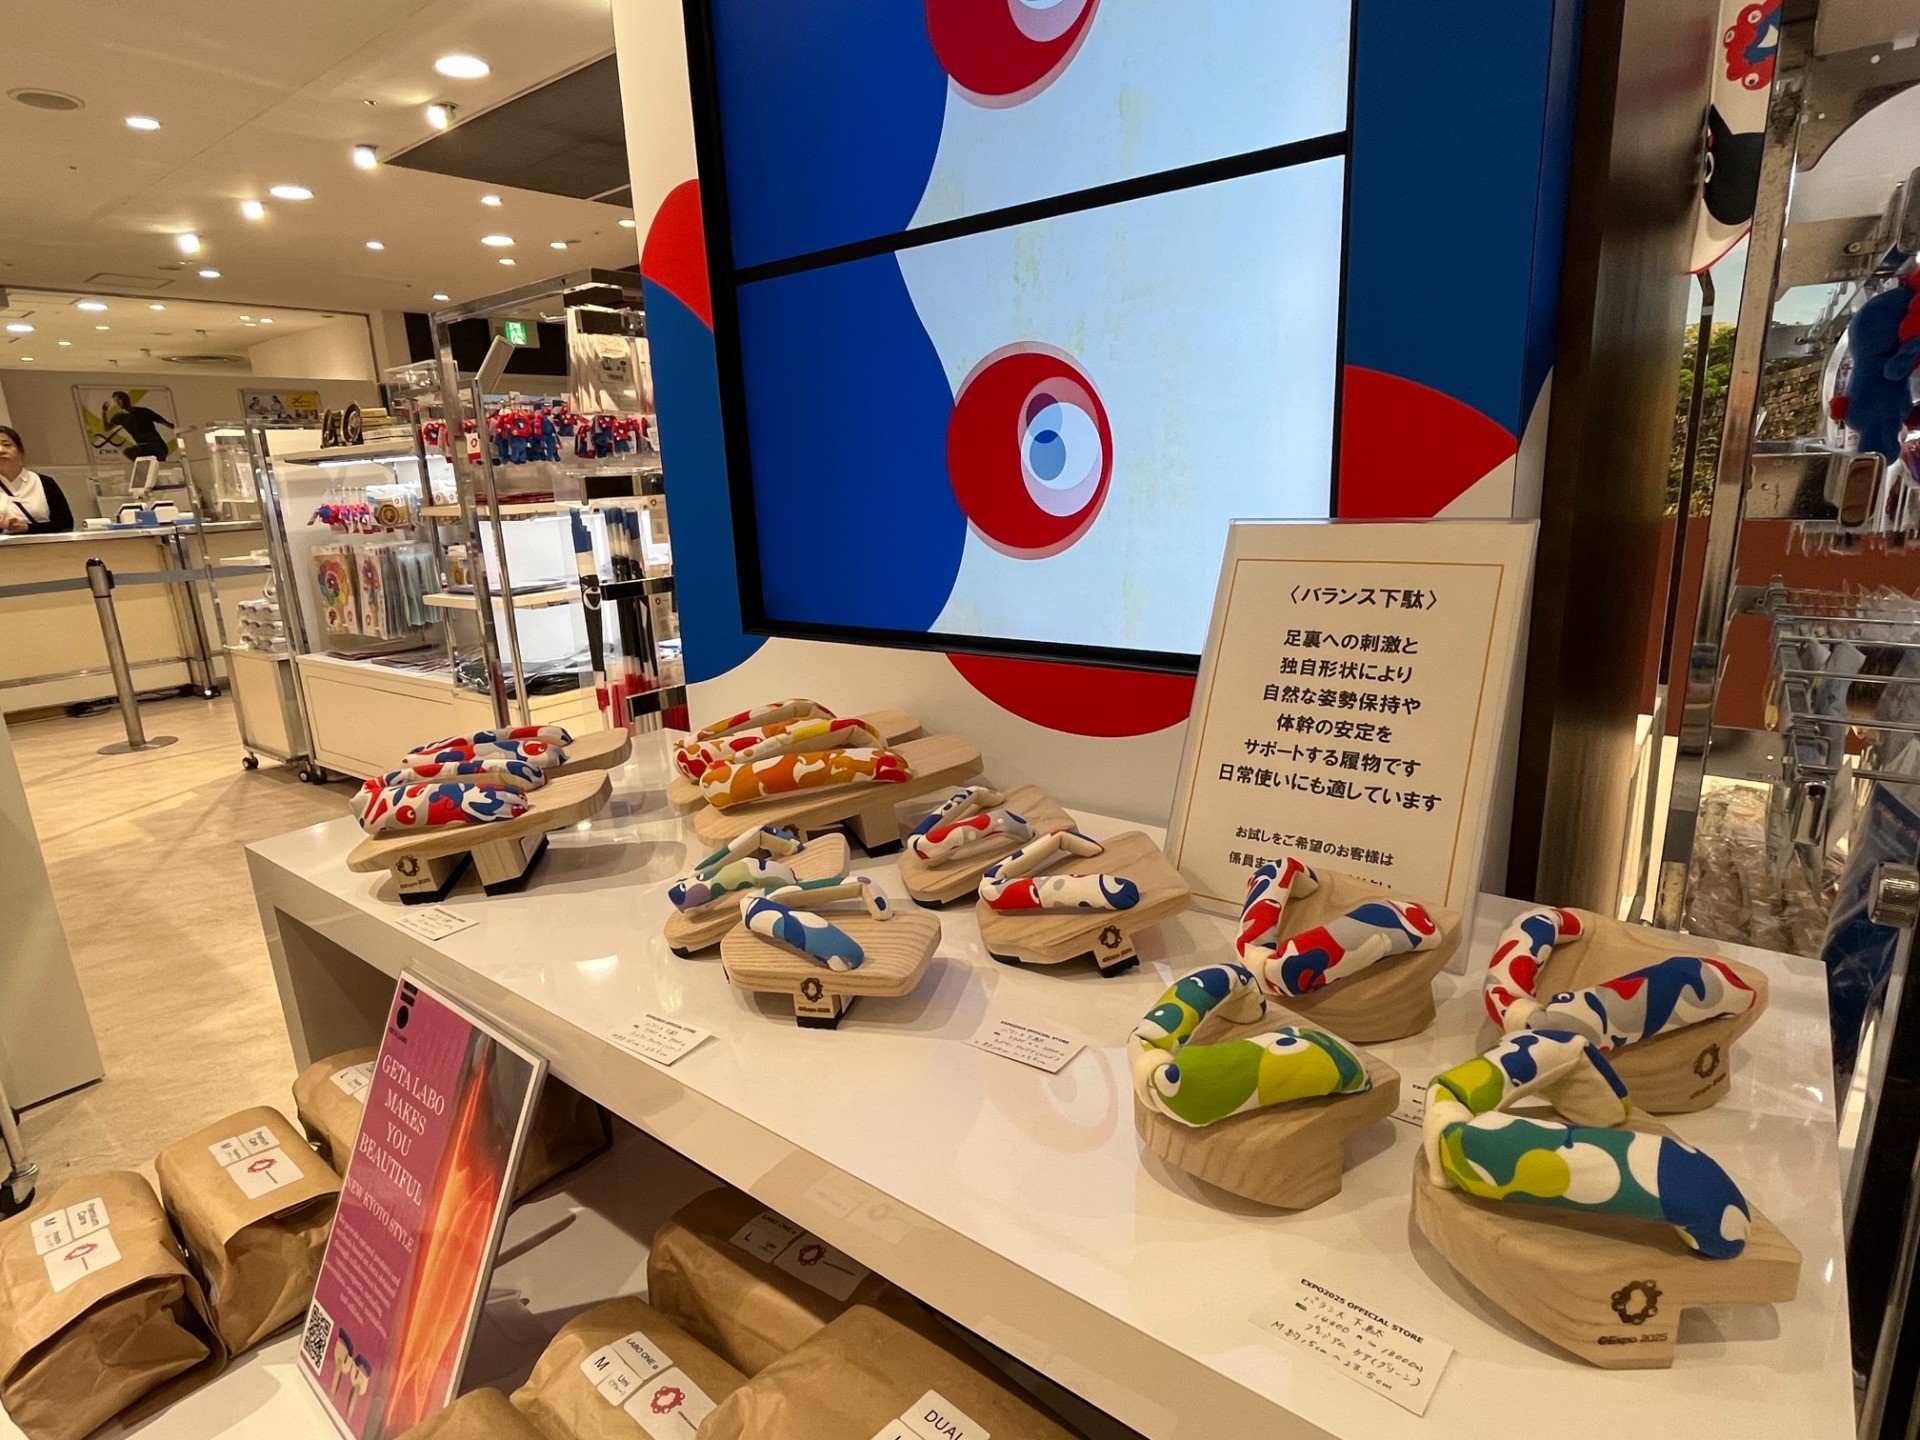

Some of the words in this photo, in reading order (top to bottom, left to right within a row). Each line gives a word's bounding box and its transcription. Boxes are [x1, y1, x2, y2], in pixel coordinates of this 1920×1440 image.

[1283, 629, 1419, 655] 足裏への刺激と
[1279, 657, 1413, 684] 独自形状により
[1262, 684, 1422, 716] 自然な姿勢保持や
[1276, 713, 1393, 744] 体幹の安定を
[1244, 738, 1422, 777] サポートする履物です
[1218, 763, 1442, 812] 日常使いにも適しています
[1235, 826, 1394, 867] お試しをご希望のお客様は
[382, 1054, 411, 1092] GETA
[412, 1076, 445, 1116] LABO
[384, 1088, 428, 1136] MAKES
[386, 1121, 412, 1157] YOU
[358, 1132, 423, 1206] BEAUTIFUL
[43, 1217, 57, 1227] M
[77, 1210, 88, 1226] Care
[345, 1175, 363, 1199] NEW
[363, 1192, 389, 1226] KYOTO
[388, 1218, 415, 1253] STYLE
[744, 1232, 752, 1241] L
[1301, 1278, 1346, 1304] EXPO2025
[1347, 1302, 1389, 1328] OFFICIAL
[1391, 1324, 1424, 1344] STORE
[626, 1338, 643, 1354] LABO
[640, 1351, 656, 1366] ONE
[1640, 1332, 1669, 1343] 2025
[594, 1356, 610, 1371] M
